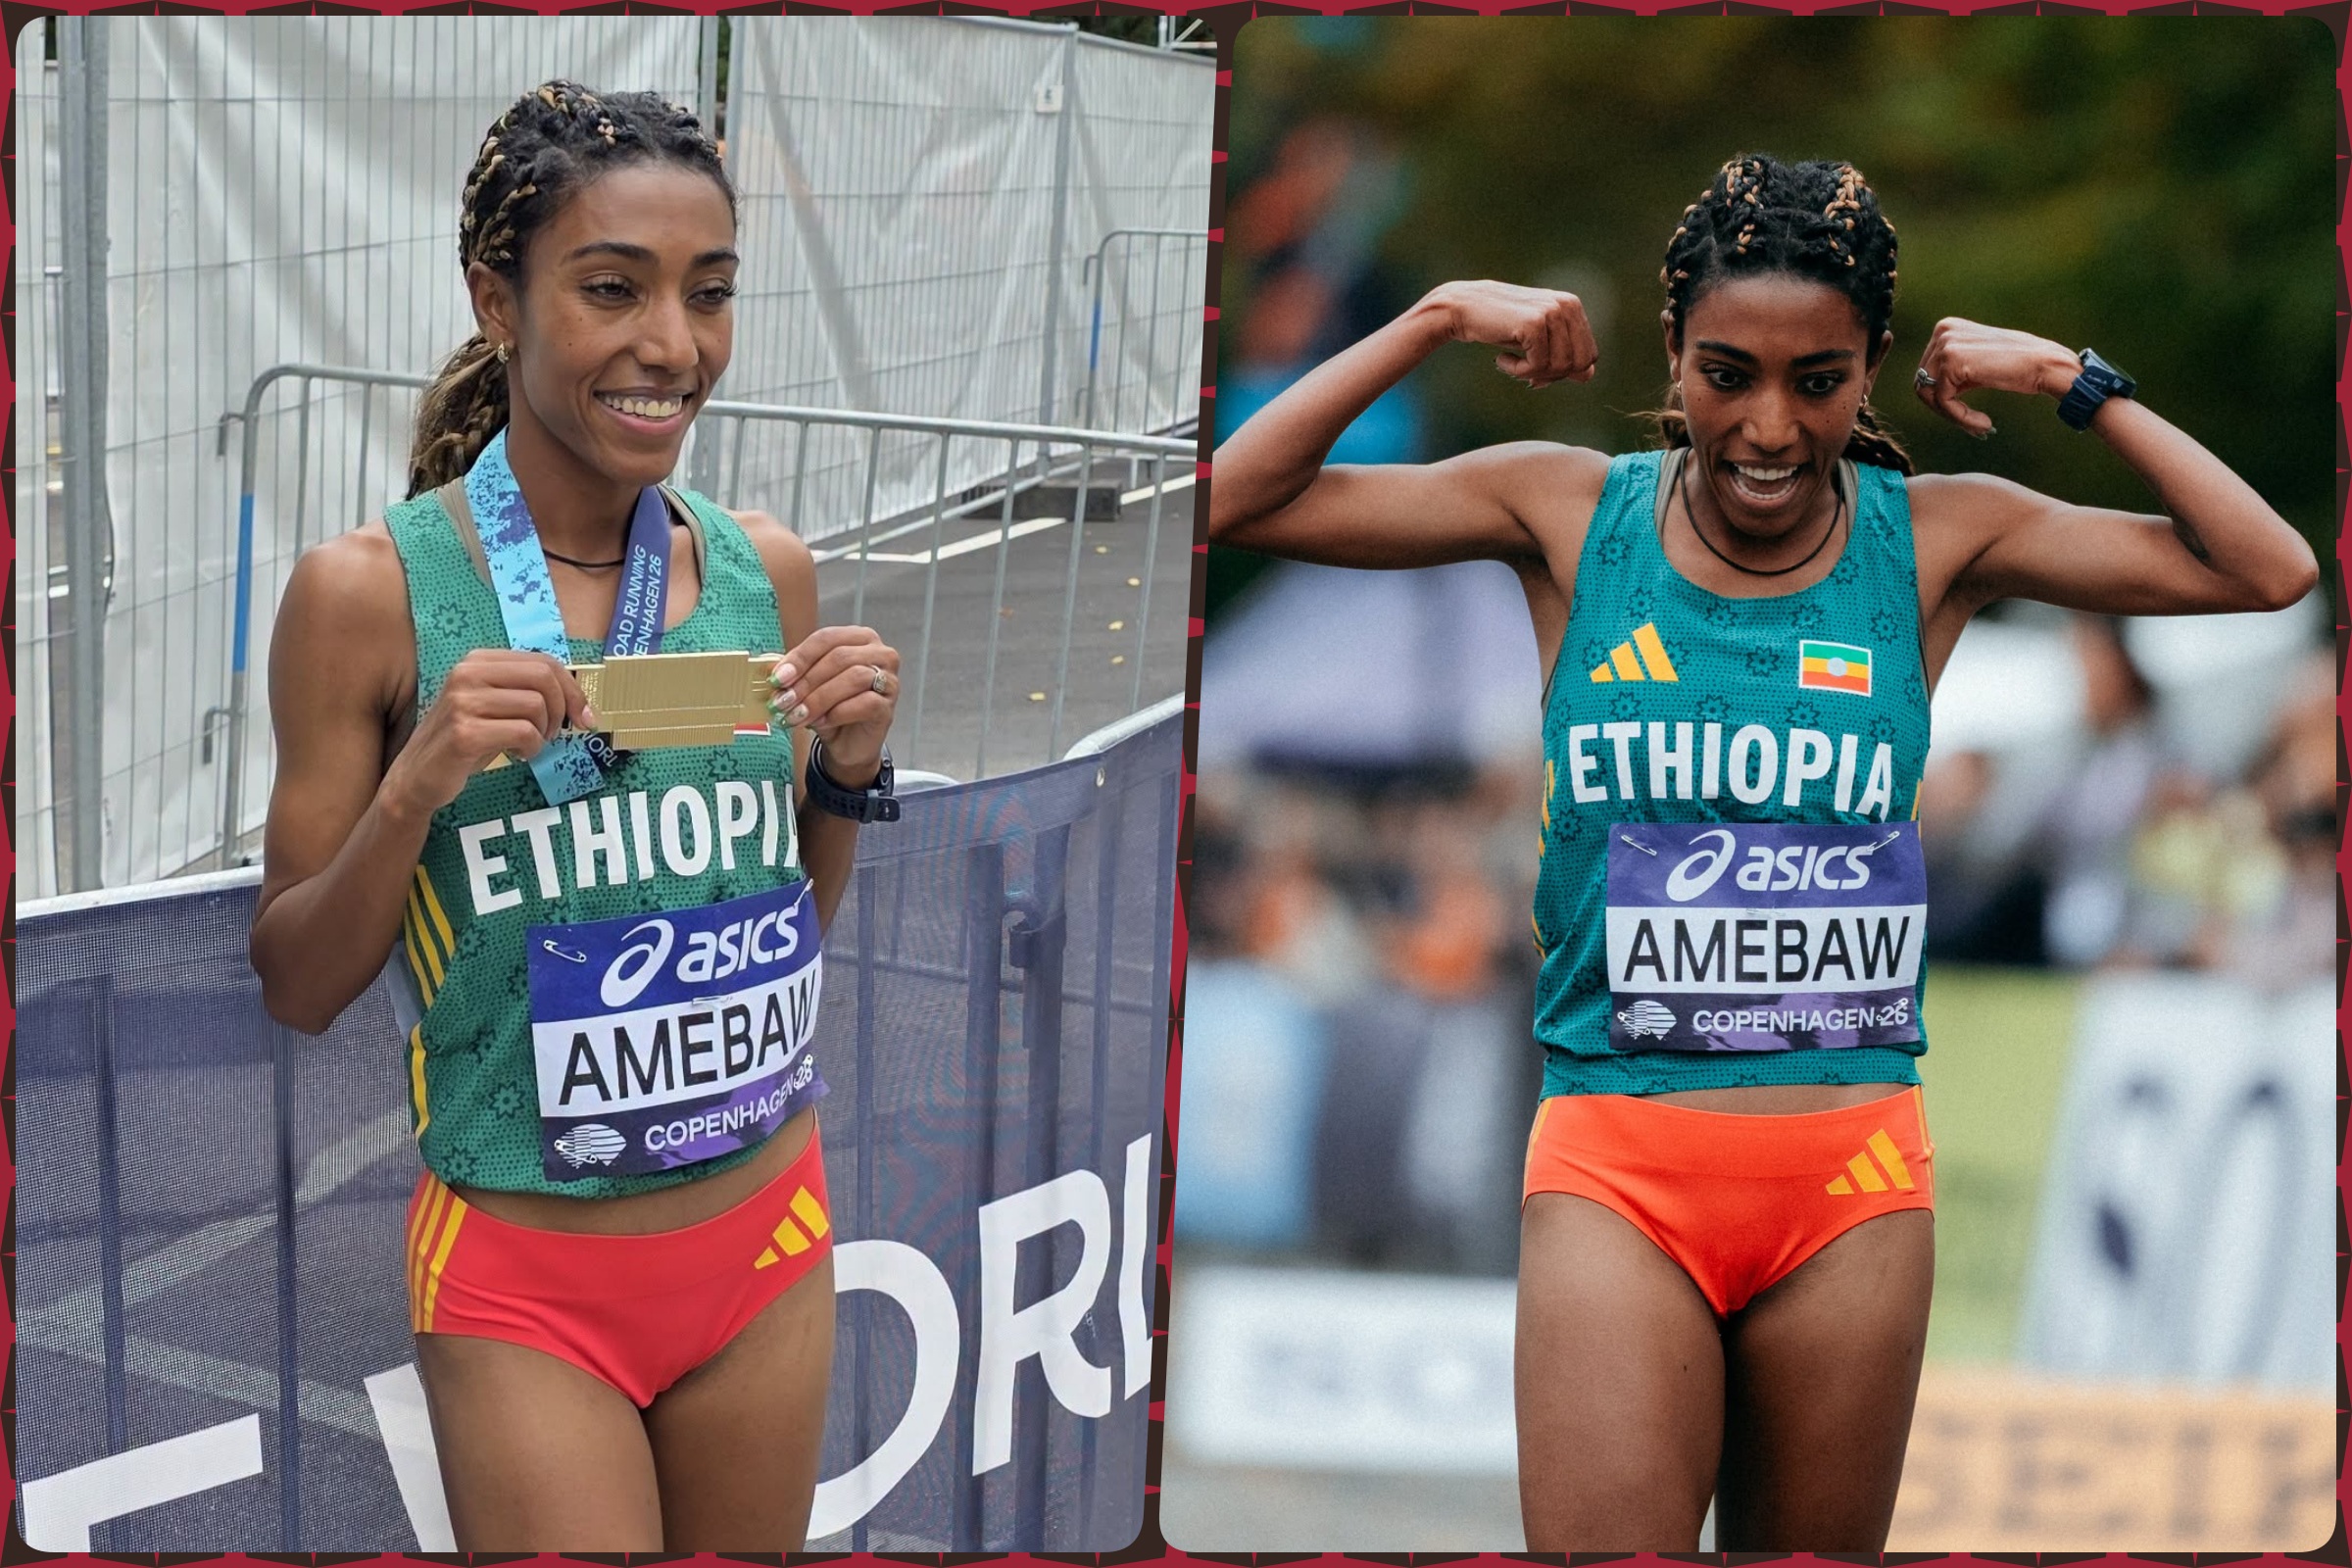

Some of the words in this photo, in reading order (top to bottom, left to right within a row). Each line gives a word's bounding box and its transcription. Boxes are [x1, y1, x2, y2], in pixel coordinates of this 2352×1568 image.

[623, 544, 647, 618] RUNNING
[631, 574, 661, 656] ENHAGEN
[649, 554, 662, 576] 26
[613, 618, 635, 657] OAD
[1568, 721, 1891, 823] ETHIOPIA
[1736, 845, 1871, 892] asics
[676, 905, 800, 983] asics
[1623, 915, 1911, 983] AMEBAW
[558, 967, 816, 1106] AMEBAW
[1692, 1006, 1876, 1033] COPENHAGEN
[1879, 1004, 1909, 1027] 26
[645, 1072, 794, 1152] COPENHAGEN
